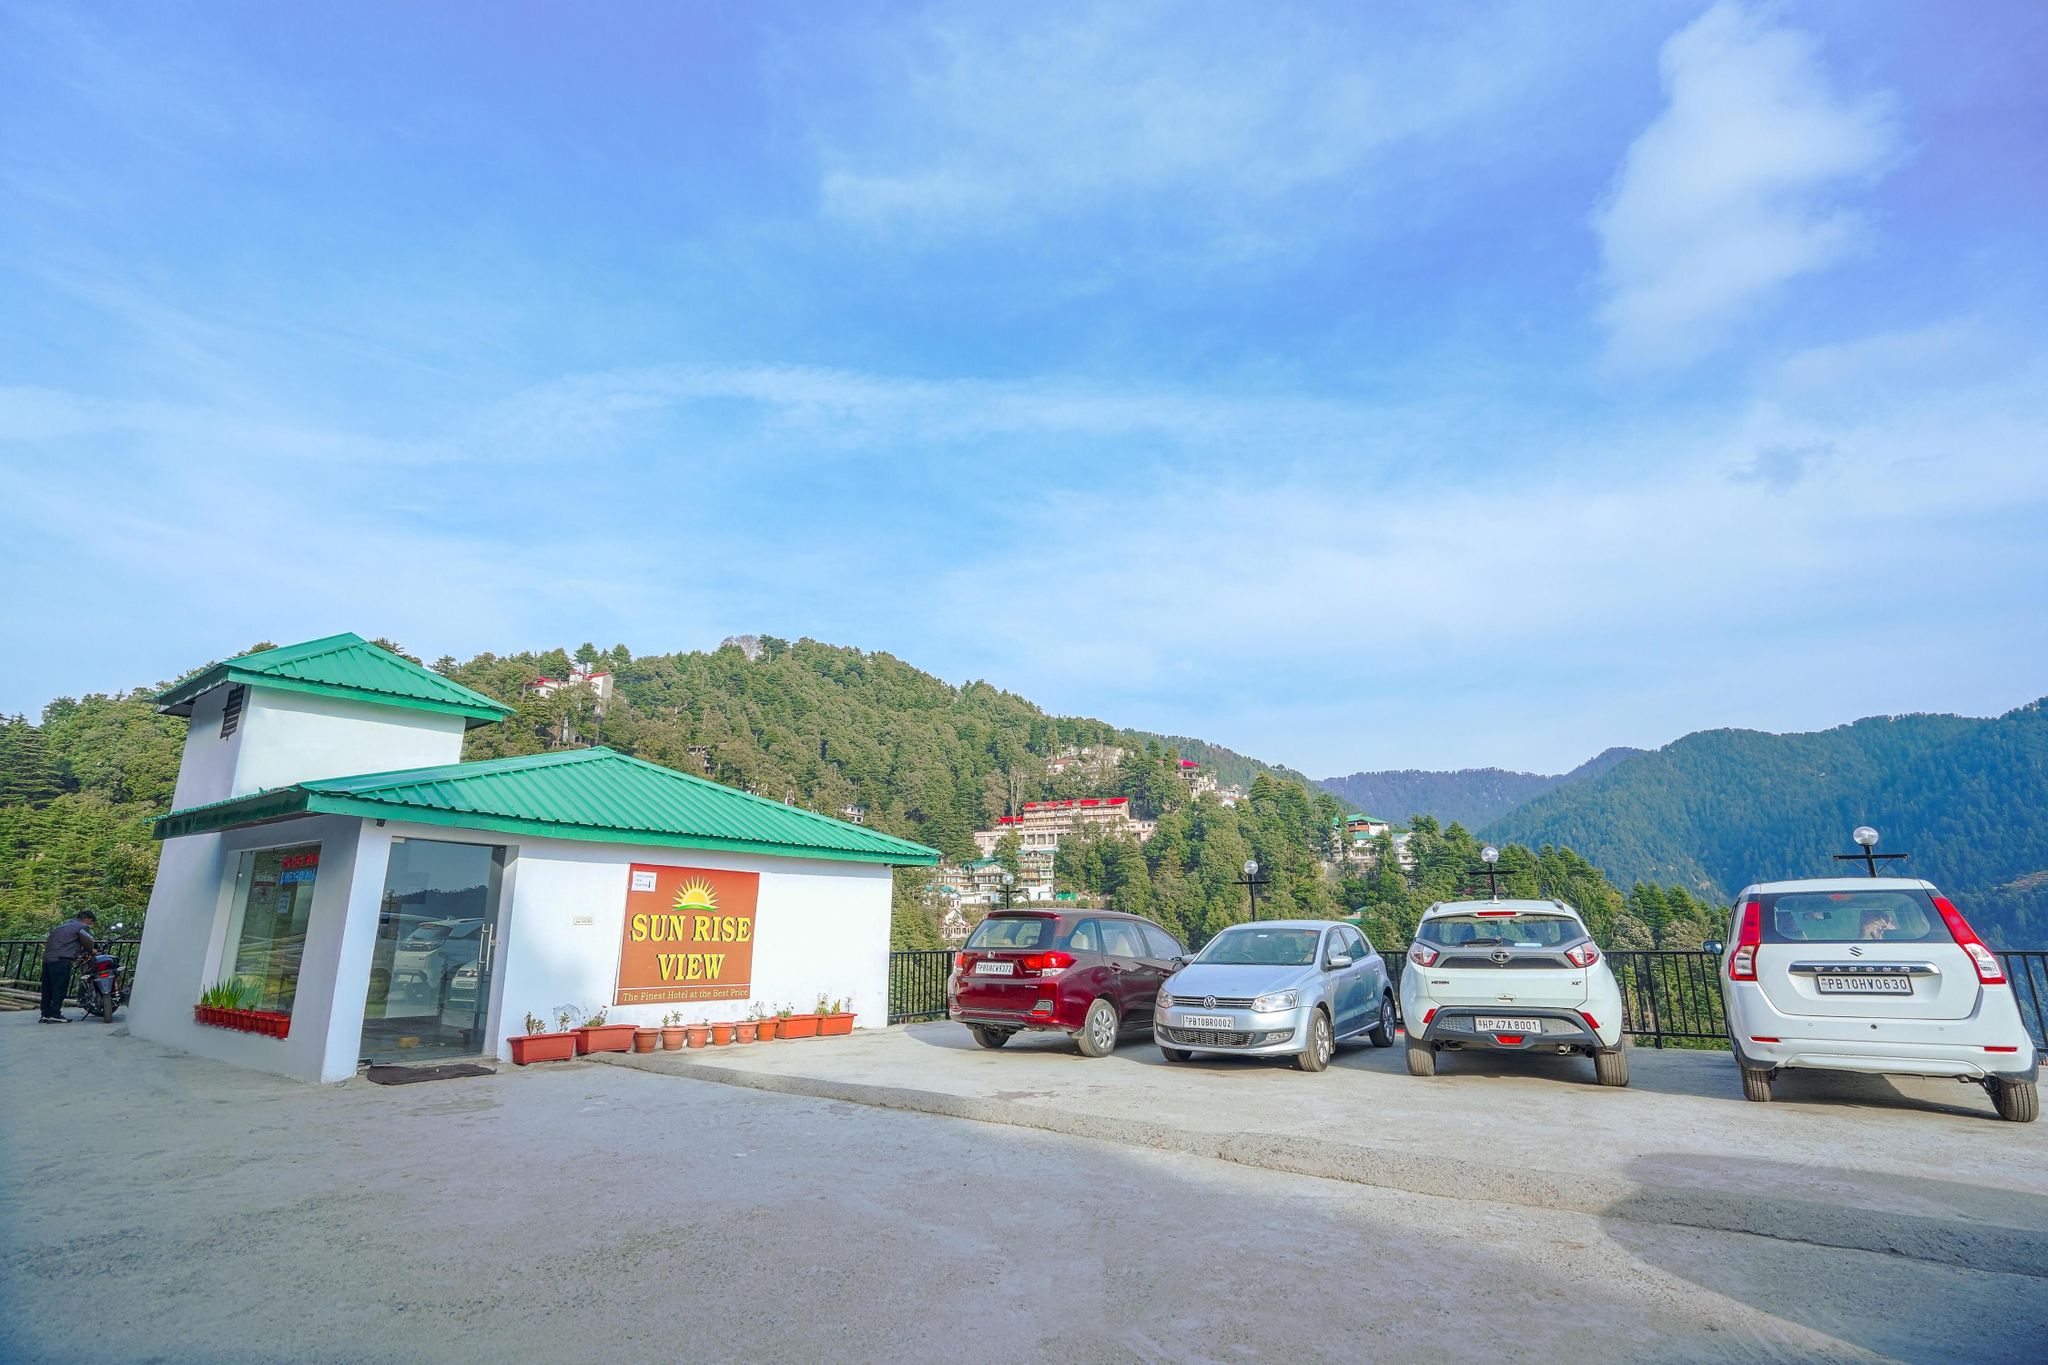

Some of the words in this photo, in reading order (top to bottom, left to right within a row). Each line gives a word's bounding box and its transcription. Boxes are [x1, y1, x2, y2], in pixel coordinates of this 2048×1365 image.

[631, 913, 686, 942] SUN
[692, 914, 752, 942] RISE
[656, 953, 725, 981] VIEW
[1828, 978, 1907, 990] PB10HV0630
[622, 992, 638, 1001] The
[641, 990, 666, 1000] Finest
[668, 990, 688, 999] Hotel
[700, 988, 712, 998] the
[713, 989, 729, 997] Best
[730, 988, 748, 997] Price
[1496, 1021, 1512, 1030] 47A
[1515, 1019, 1537, 1030] 8001
